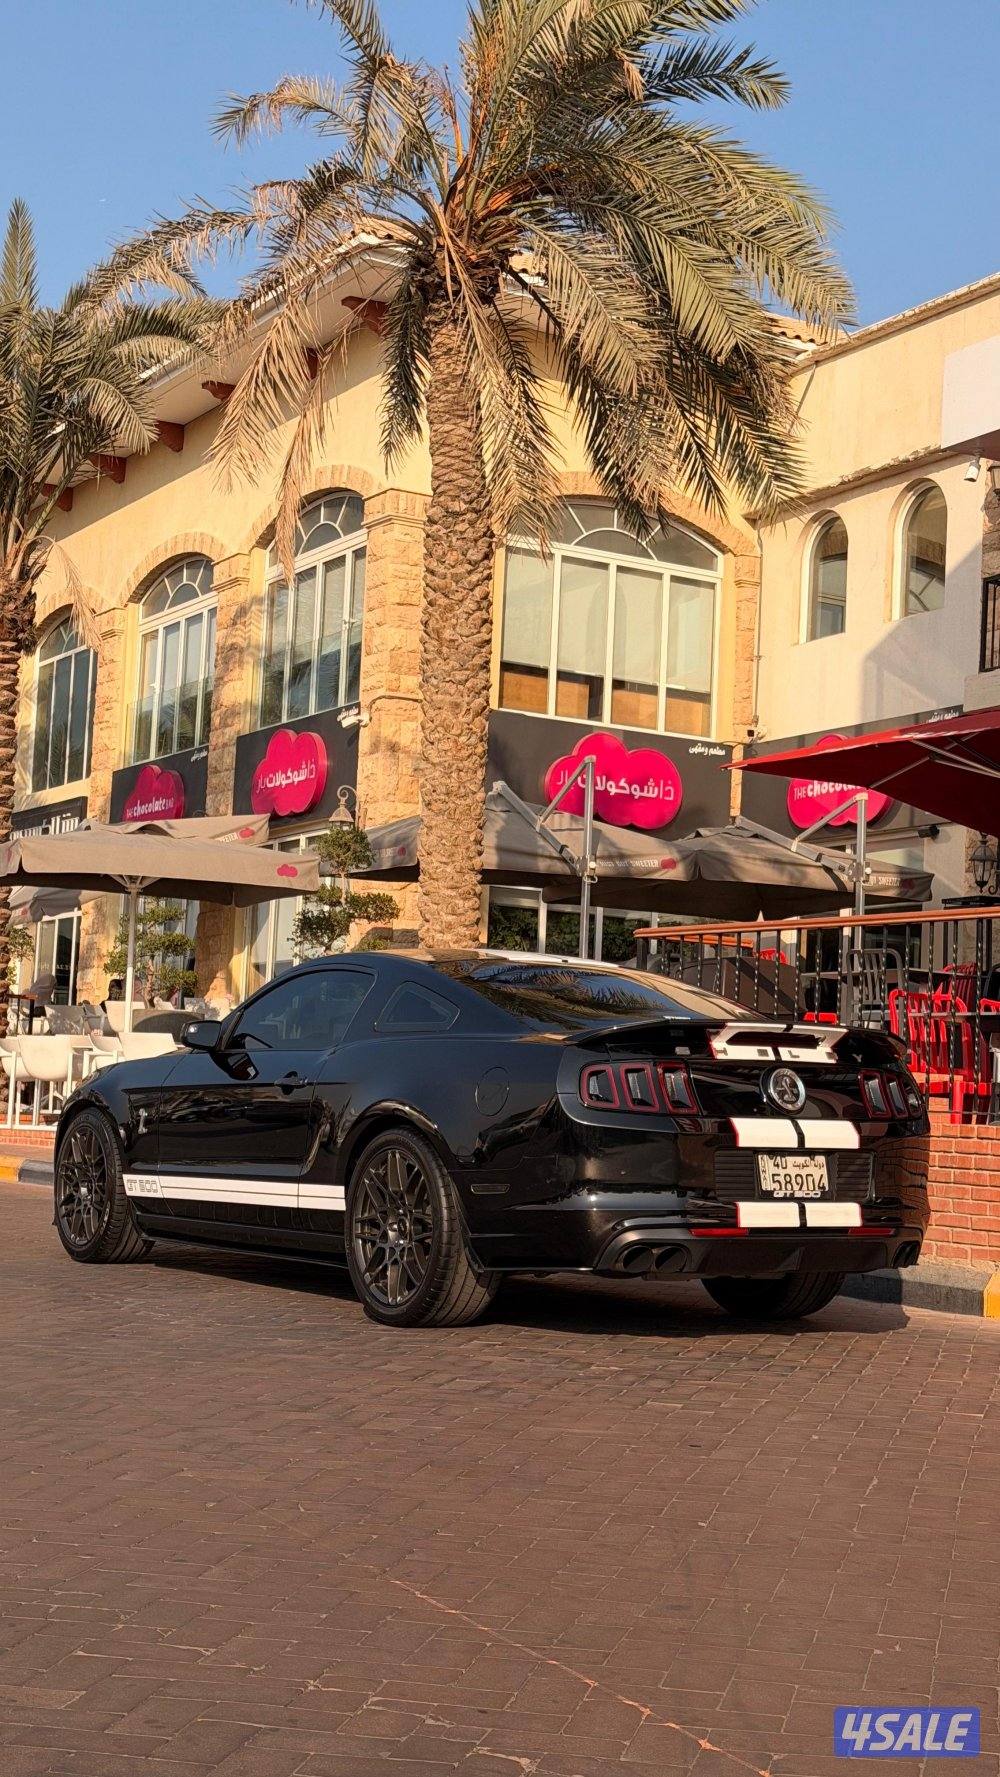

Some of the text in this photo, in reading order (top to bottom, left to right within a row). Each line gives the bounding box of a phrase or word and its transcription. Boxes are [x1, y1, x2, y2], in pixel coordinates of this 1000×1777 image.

[688, 742, 726, 757] مطعم ومقهى
[793, 780, 866, 801] THE choco
[133, 796, 166, 818] chocolate
[629, 859, 659, 869] SWEETER
[771, 1173, 827, 1191] 58904
